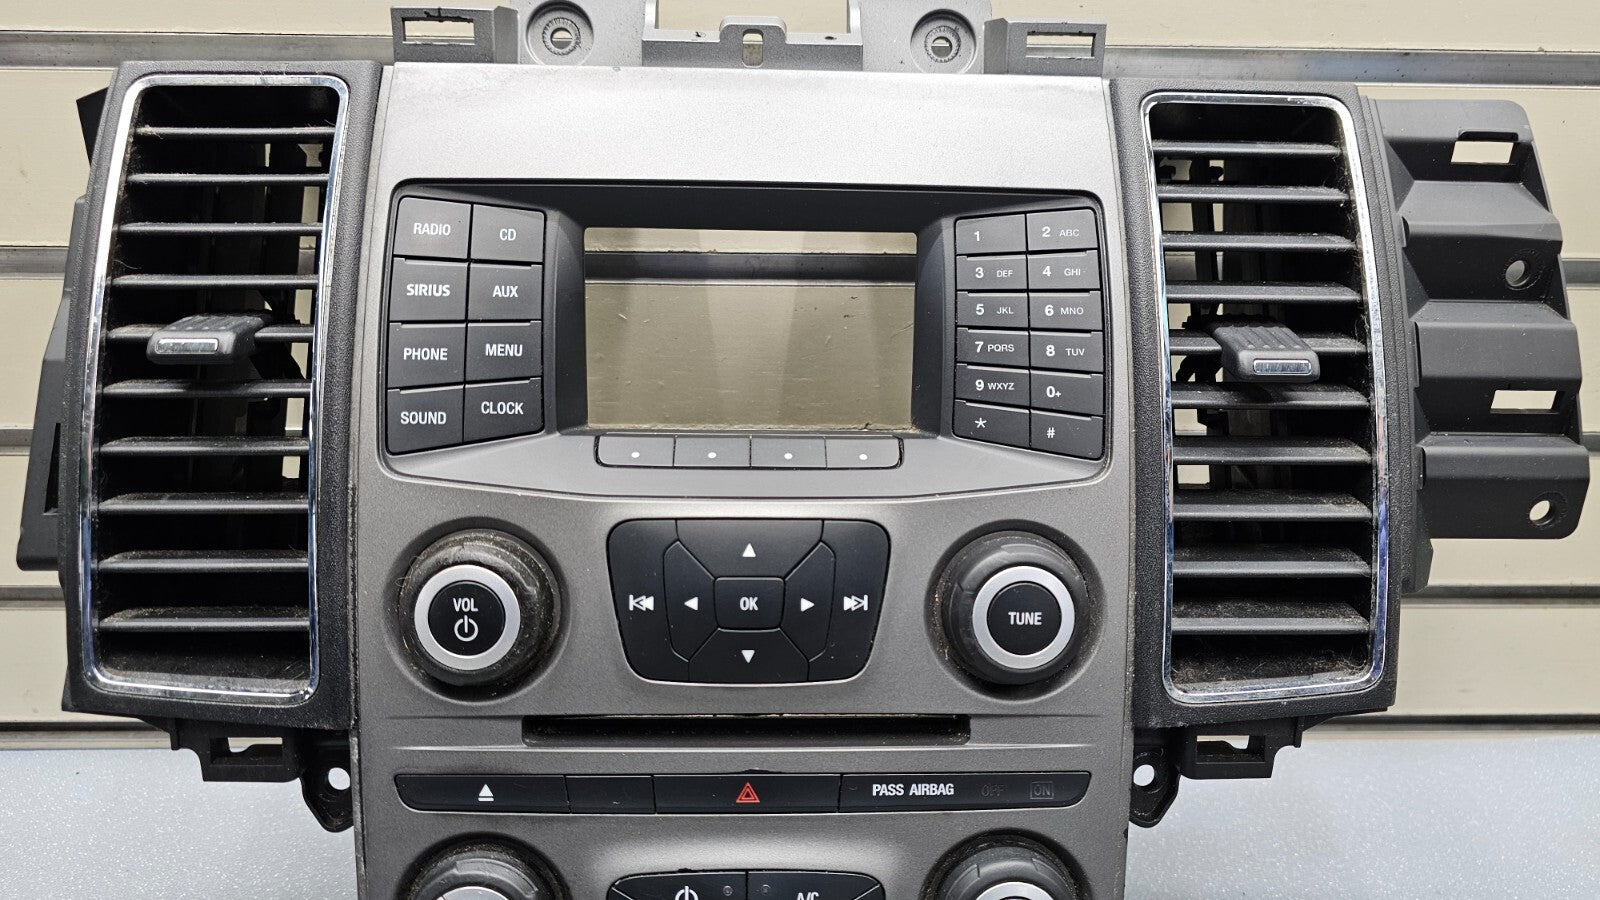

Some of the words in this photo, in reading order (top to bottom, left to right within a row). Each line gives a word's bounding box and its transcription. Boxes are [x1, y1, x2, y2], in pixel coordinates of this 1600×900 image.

[414, 222, 451, 236] RADIO
[499, 228, 517, 241] CD
[1041, 226, 1051, 238] 2
[1059, 228, 1080, 238] ABC
[974, 231, 981, 242] 1
[975, 267, 985, 279] 3
[996, 270, 1014, 278] DEF
[1042, 265, 1052, 277] 4
[1064, 268, 1081, 277] GHI
[406, 284, 451, 297] SIRIUS
[492, 285, 519, 298] AUX
[975, 303, 985, 316] 5
[996, 307, 1014, 315] JKL
[1044, 305, 1055, 317] 6
[1060, 307, 1085, 315] MNO
[485, 343, 523, 357] MENU
[974, 341, 984, 353] 7
[987, 343, 1015, 353] PQRS
[1045, 345, 1056, 357] 8
[1065, 348, 1085, 357] TUV
[403, 347, 448, 361] PHONE
[975, 379, 985, 391] 9
[987, 382, 1015, 391] WXYZ
[480, 401, 524, 415] CLOCK
[400, 411, 447, 425] SOUND
[453, 597, 478, 612] VOL
[739, 597, 759, 611] OK
[1008, 611, 1043, 626] TUNE
[872, 783, 905, 796] PASS
[909, 783, 955, 796] AIRBAG
[1033, 784, 1051, 797] ON
